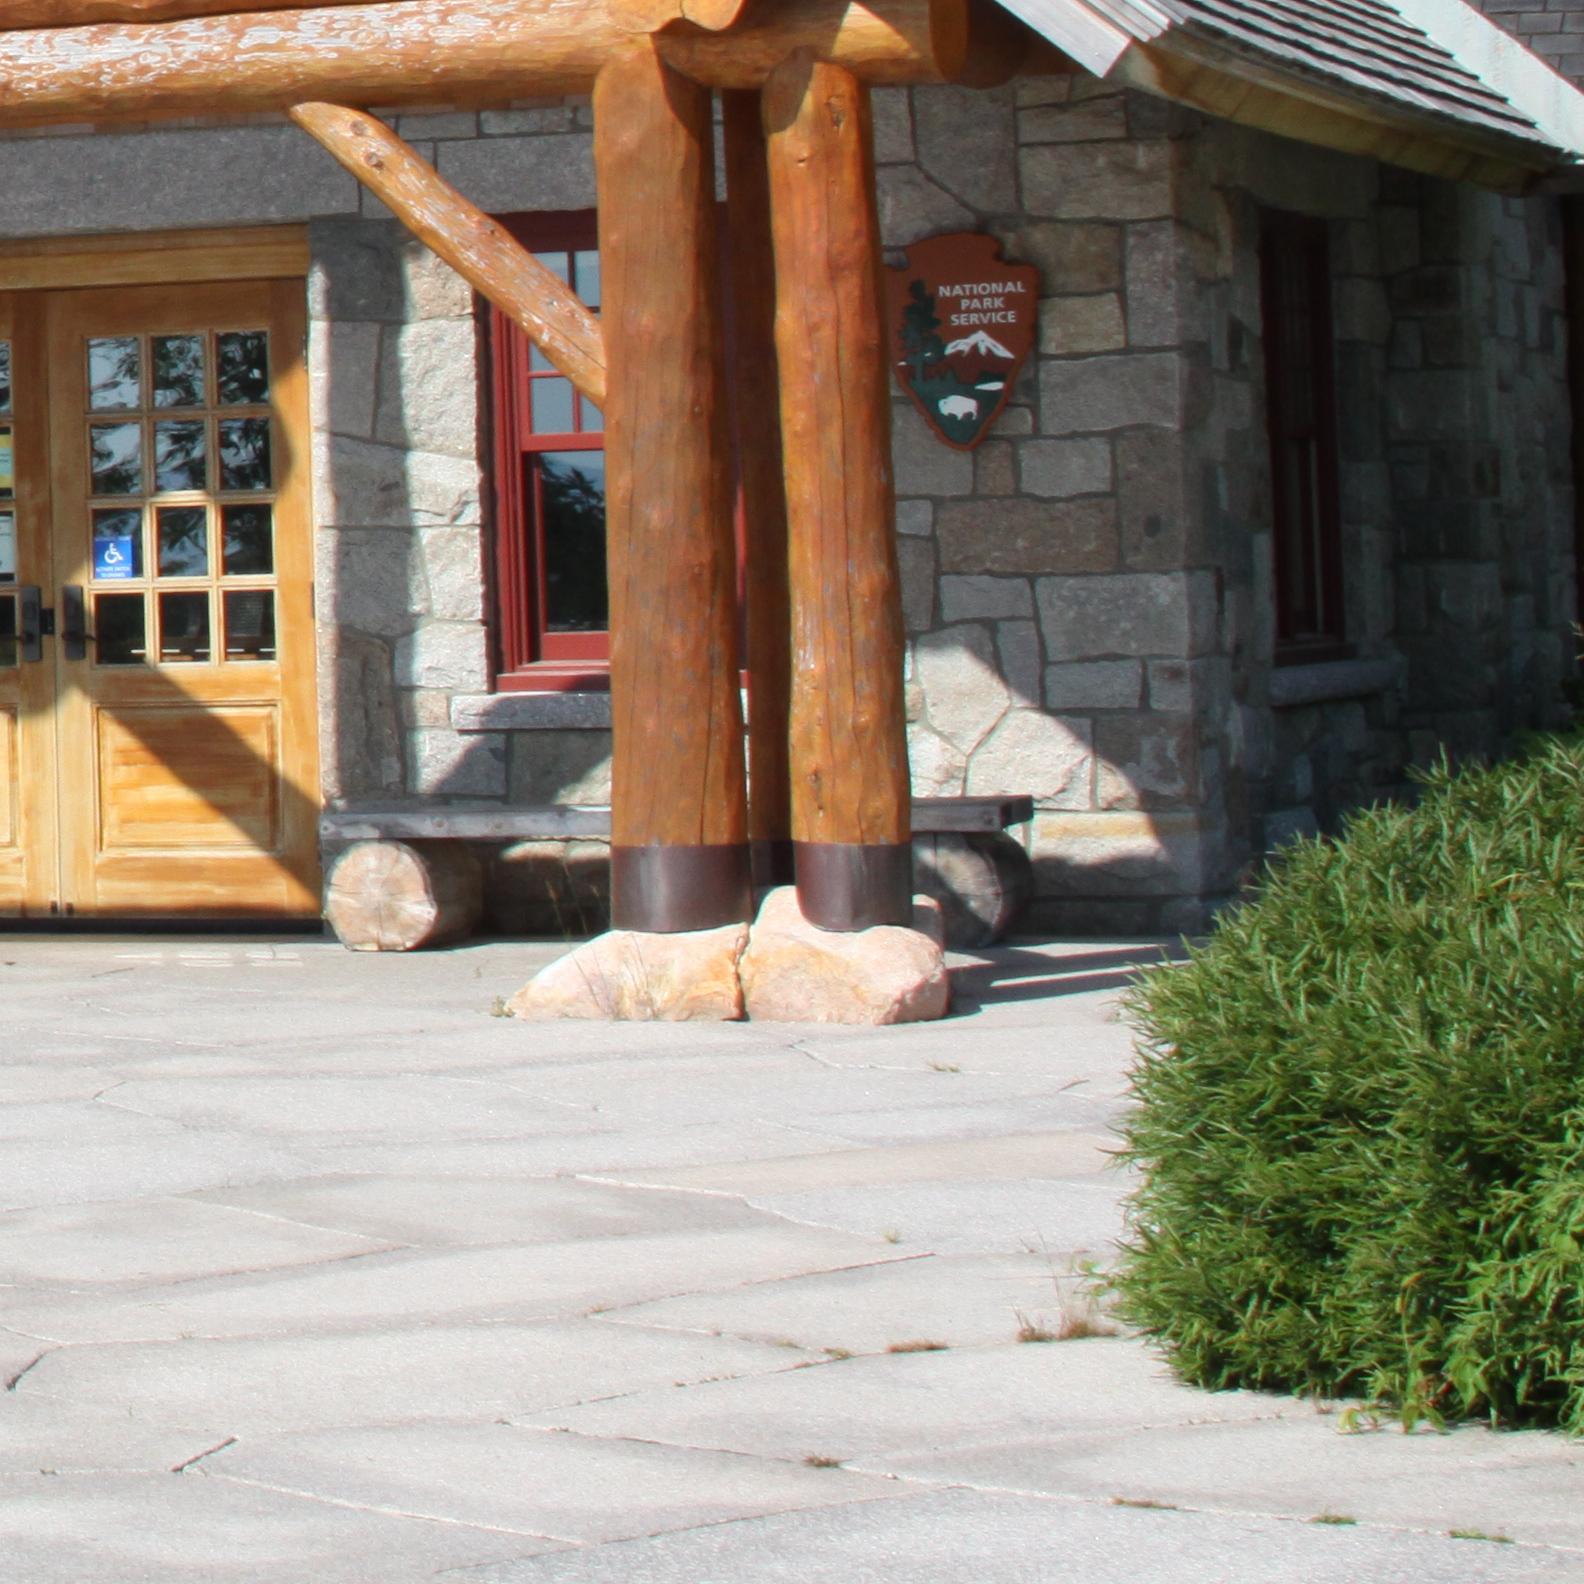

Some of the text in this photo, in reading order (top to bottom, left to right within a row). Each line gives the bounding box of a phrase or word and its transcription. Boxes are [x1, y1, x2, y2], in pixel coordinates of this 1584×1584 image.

[938, 281, 1027, 297] NATIONAL
[960, 297, 1005, 311] PARK
[951, 310, 1017, 326] SERVICE
